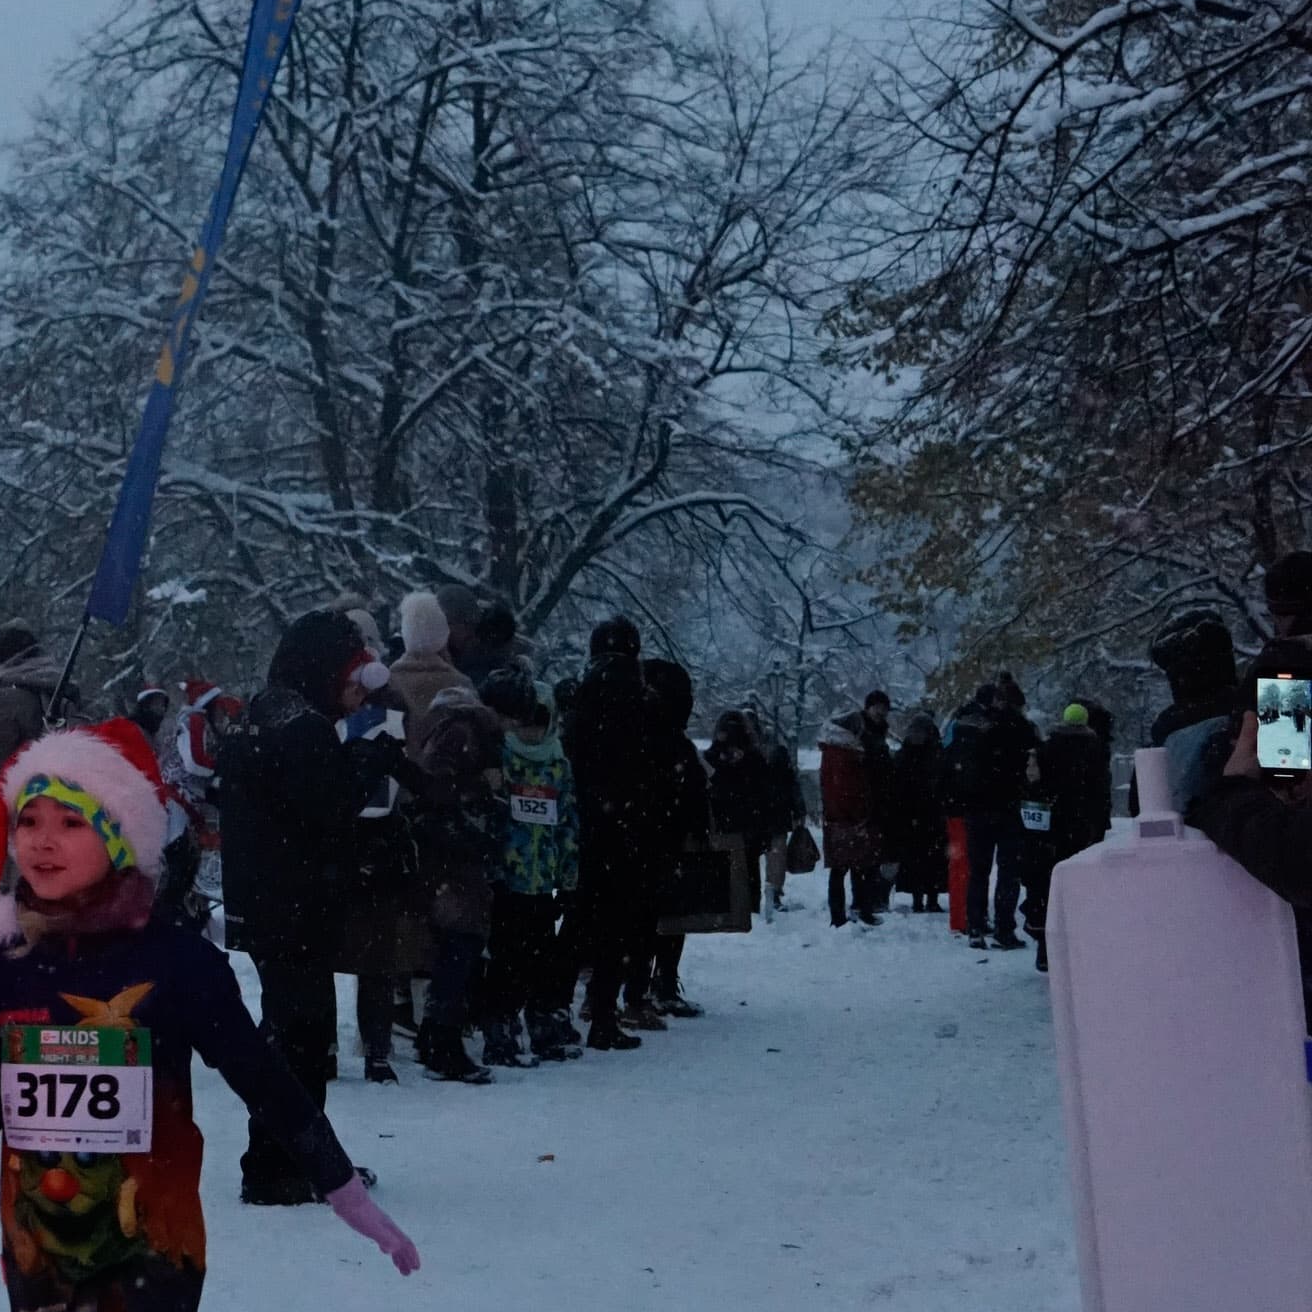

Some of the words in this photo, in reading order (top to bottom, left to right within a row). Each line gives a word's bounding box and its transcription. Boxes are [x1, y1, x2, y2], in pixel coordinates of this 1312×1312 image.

[519, 799, 547, 814] 1525
[61, 1030, 100, 1045] KIDS
[17, 1072, 120, 1119] 3178
